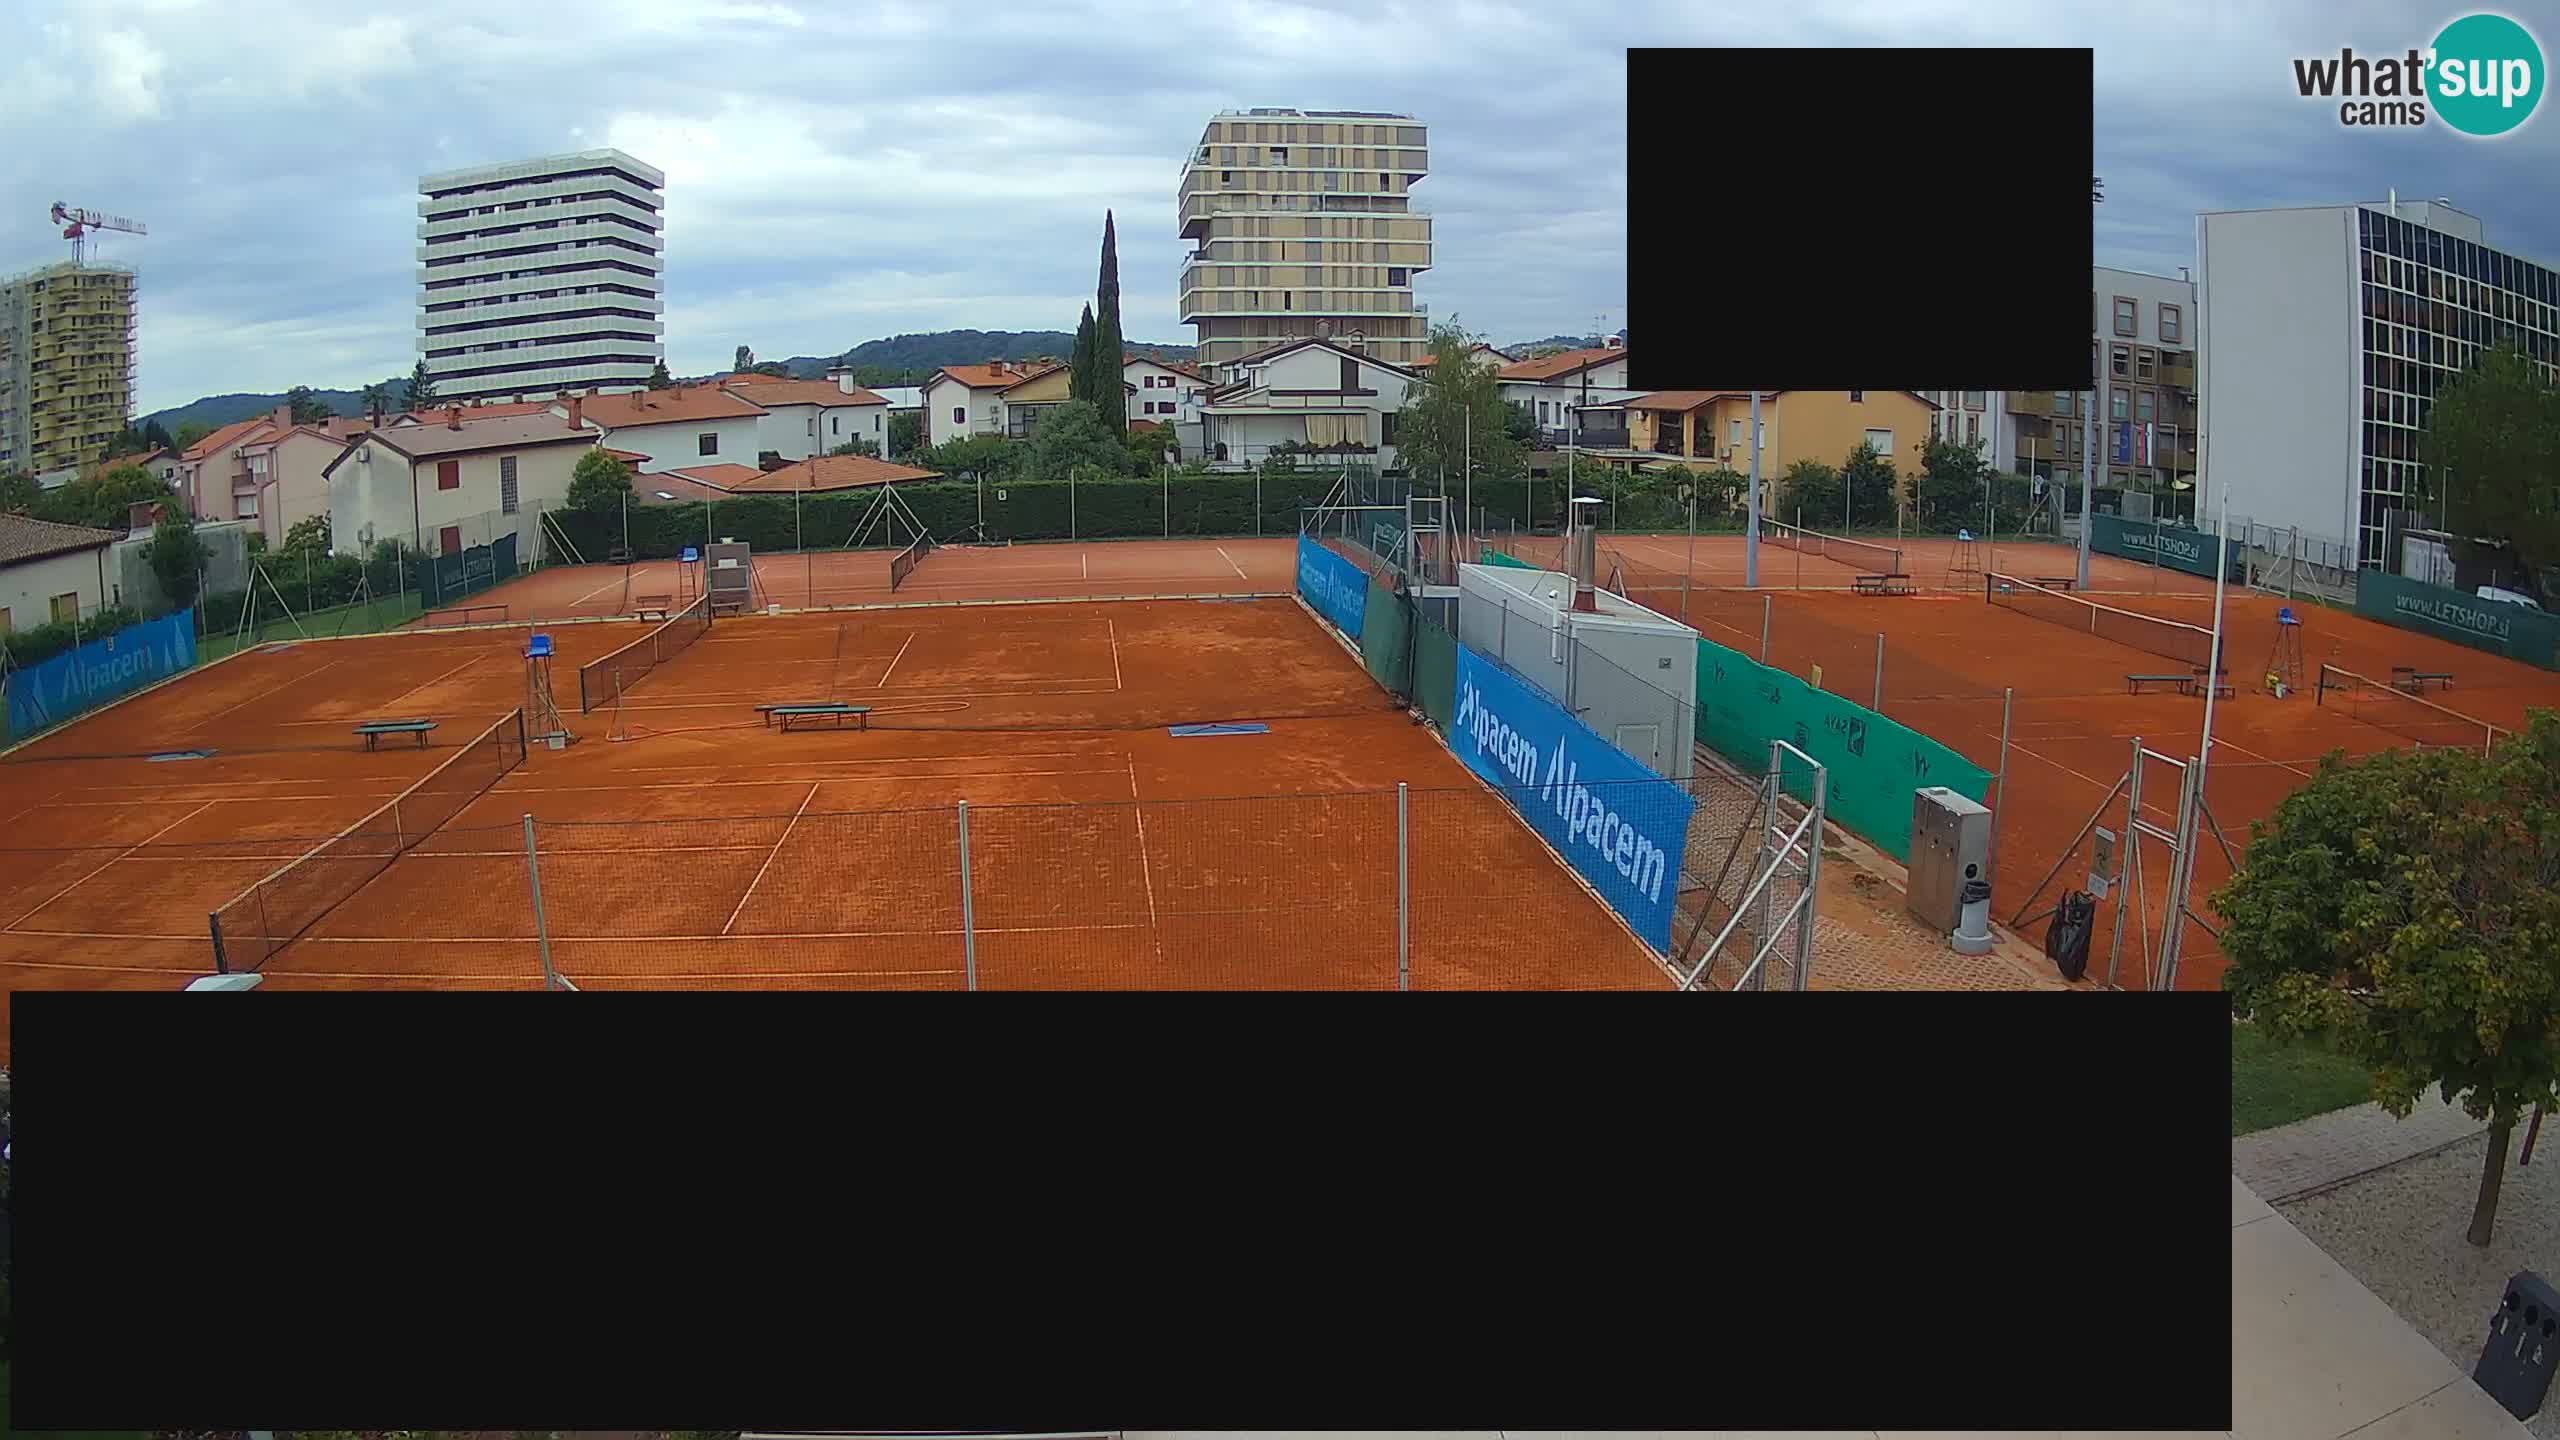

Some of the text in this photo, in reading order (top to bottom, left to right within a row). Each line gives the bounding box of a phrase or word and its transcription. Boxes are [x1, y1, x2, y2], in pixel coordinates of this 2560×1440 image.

[2121, 532, 2201, 559] www.LTSHOP.si
[2396, 593, 2510, 637] www.LETSHOP.si
[61, 648, 153, 704] Alpacem
[1457, 671, 1666, 905] Alpacem Alpacem
